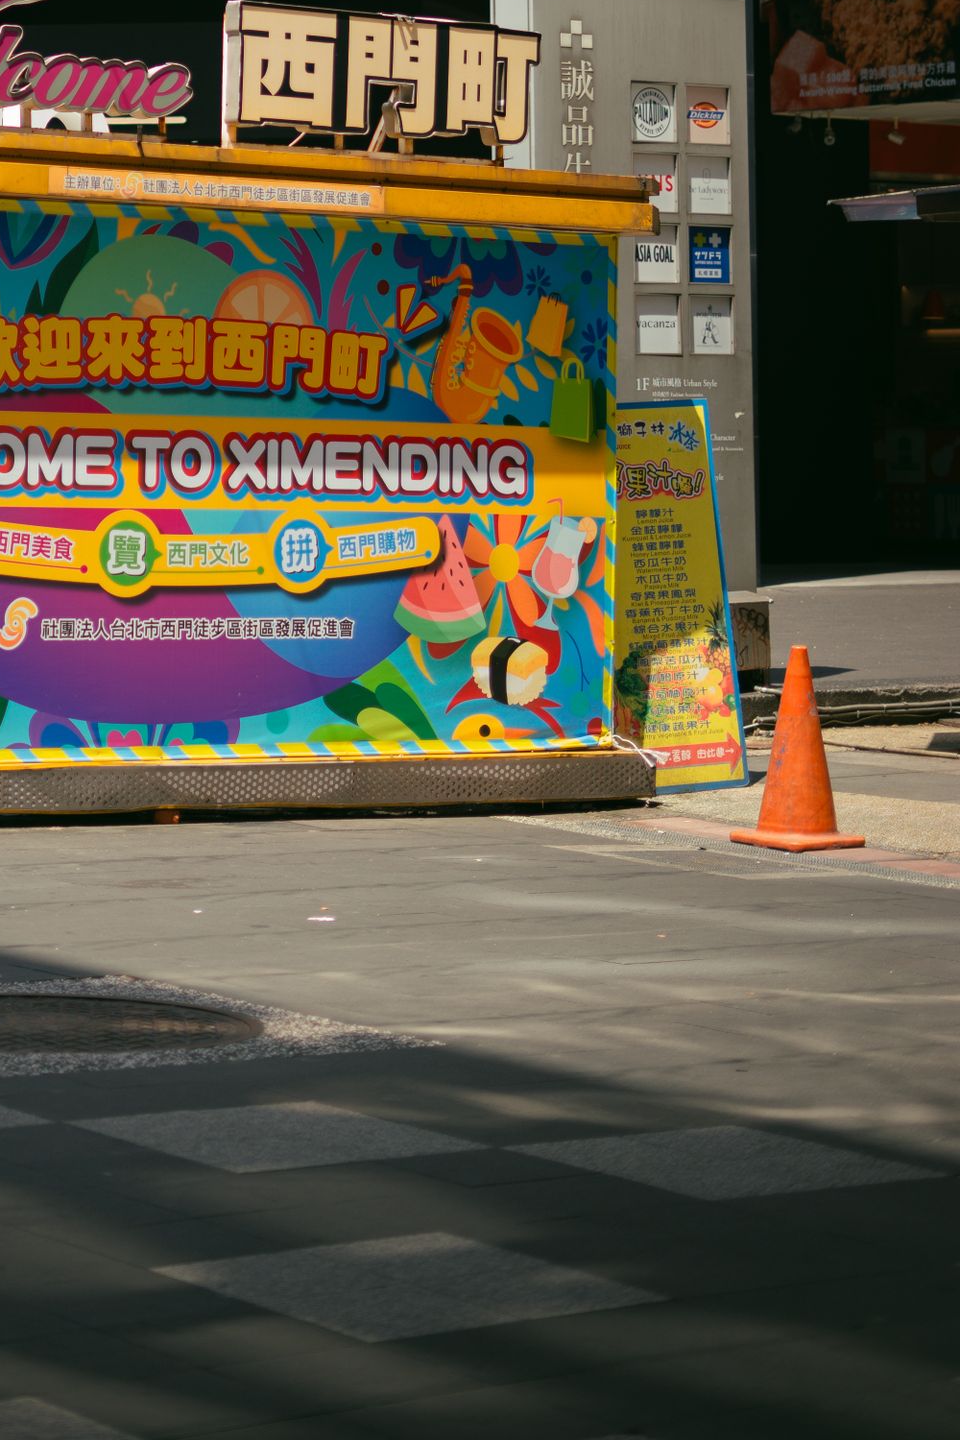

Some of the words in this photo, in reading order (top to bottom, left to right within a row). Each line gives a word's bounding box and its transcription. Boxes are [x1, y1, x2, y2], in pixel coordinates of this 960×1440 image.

[227, 0, 542, 145] 西門町
[925, 77, 956, 88] Chicken
[689, 110, 724, 121] Dickies
[143, 177, 371, 208] 社團法人台北市西門徒步區街區發展促進會
[635, 244, 652, 263] ASIA
[653, 244, 675, 263] GOAL
[636, 320, 676, 329] vacanza
[636, 378, 650, 391] 1F
[683, 379, 702, 388] Urban
[703, 378, 718, 389] Style
[616, 421, 665, 438] 獅子林
[668, 421, 700, 452] 冰茶
[132, 434, 216, 492] TO
[224, 438, 526, 498] XIMENDING
[635, 507, 675, 519] 檸檬汁
[110, 534, 143, 573] 覽
[166, 541, 250, 566] 西門文化
[281, 534, 315, 569] 拼
[338, 527, 417, 561] 西門購物
[631, 540, 685, 552] 蜂蜜檸檬
[633, 556, 687, 569] 西瓜牛奶
[635, 572, 689, 585] 木瓜牛奶
[630, 588, 697, 602] 奇異果鳳梨
[625, 604, 705, 619] 香蕉布丁牛奶
[661, 614, 686, 623] Pudding
[40, 618, 355, 642] 社團法人台北市西門徒步區街區發展促進會
[633, 620, 700, 635] 綜合水果汁
